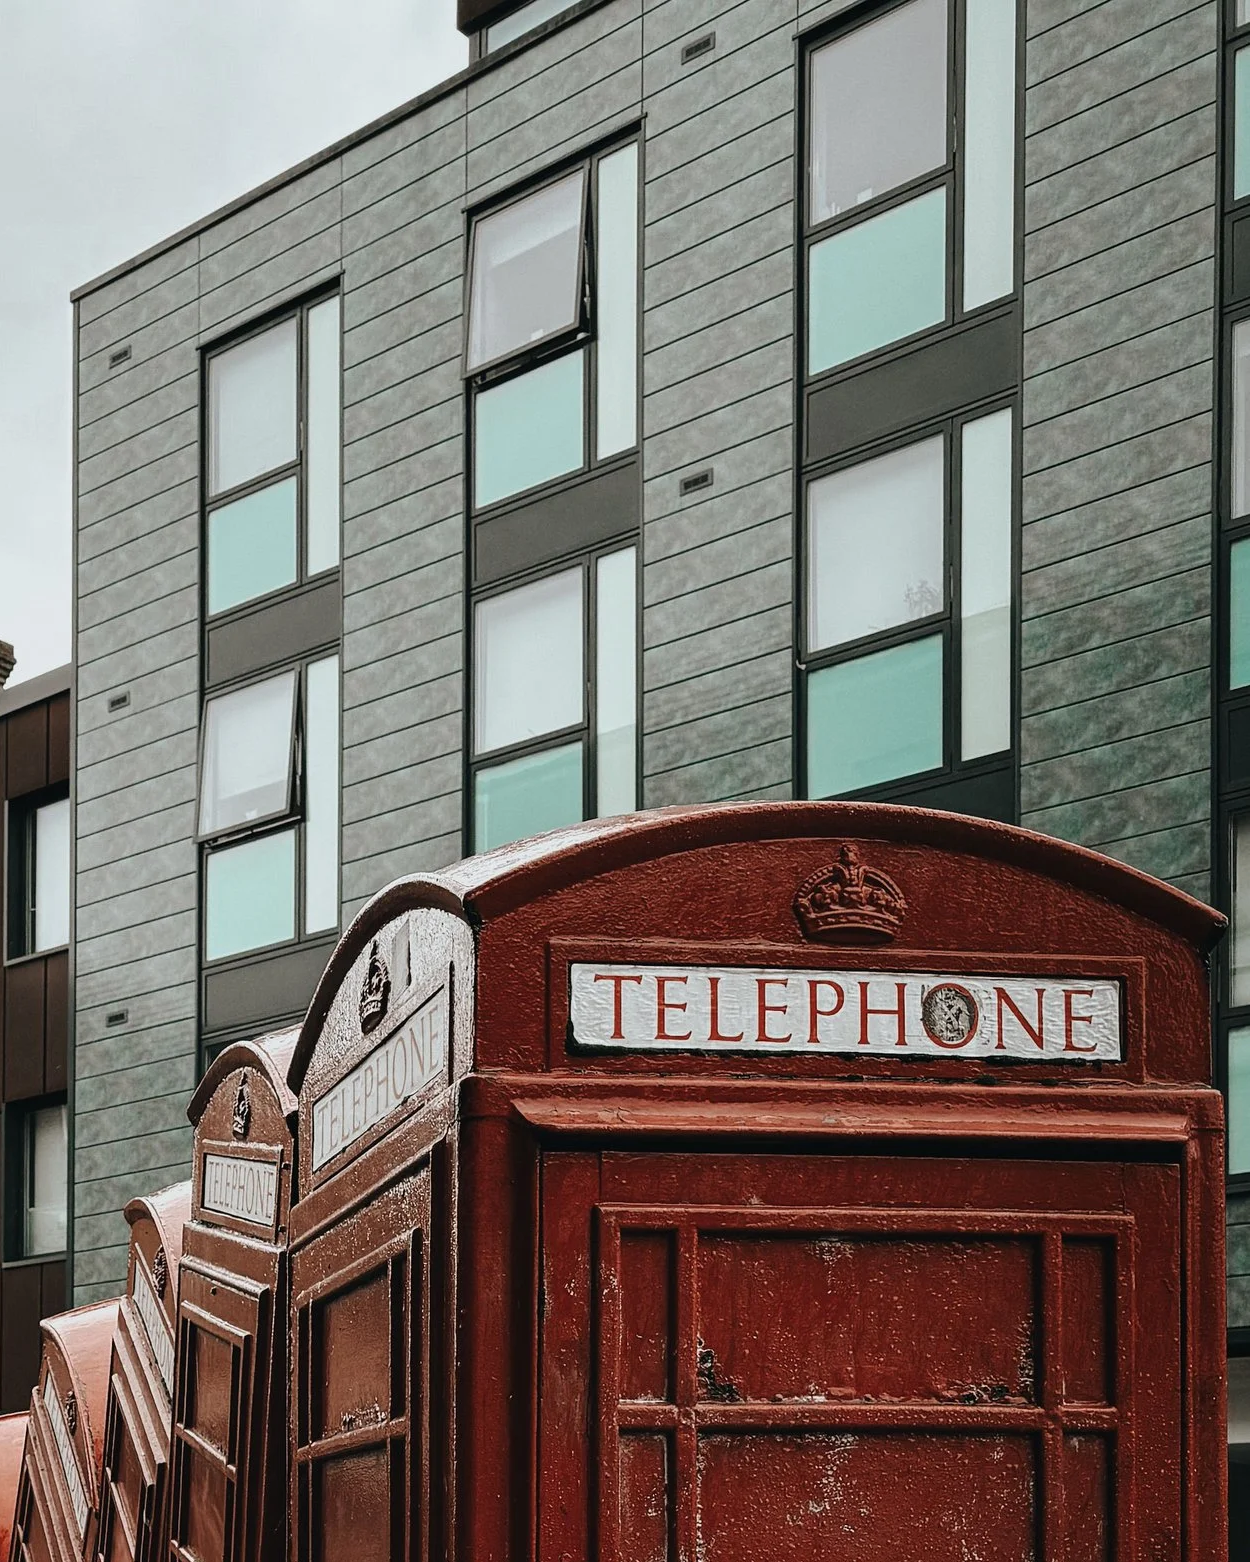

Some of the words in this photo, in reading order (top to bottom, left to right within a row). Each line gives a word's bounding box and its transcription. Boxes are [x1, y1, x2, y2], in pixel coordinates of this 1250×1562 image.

[593, 973, 1099, 1053] TELEPHONE
[317, 1005, 439, 1163] TELEPHONE
[208, 1161, 275, 1220] TELEPHONE
[134, 1264, 175, 1398] TELEPHON
